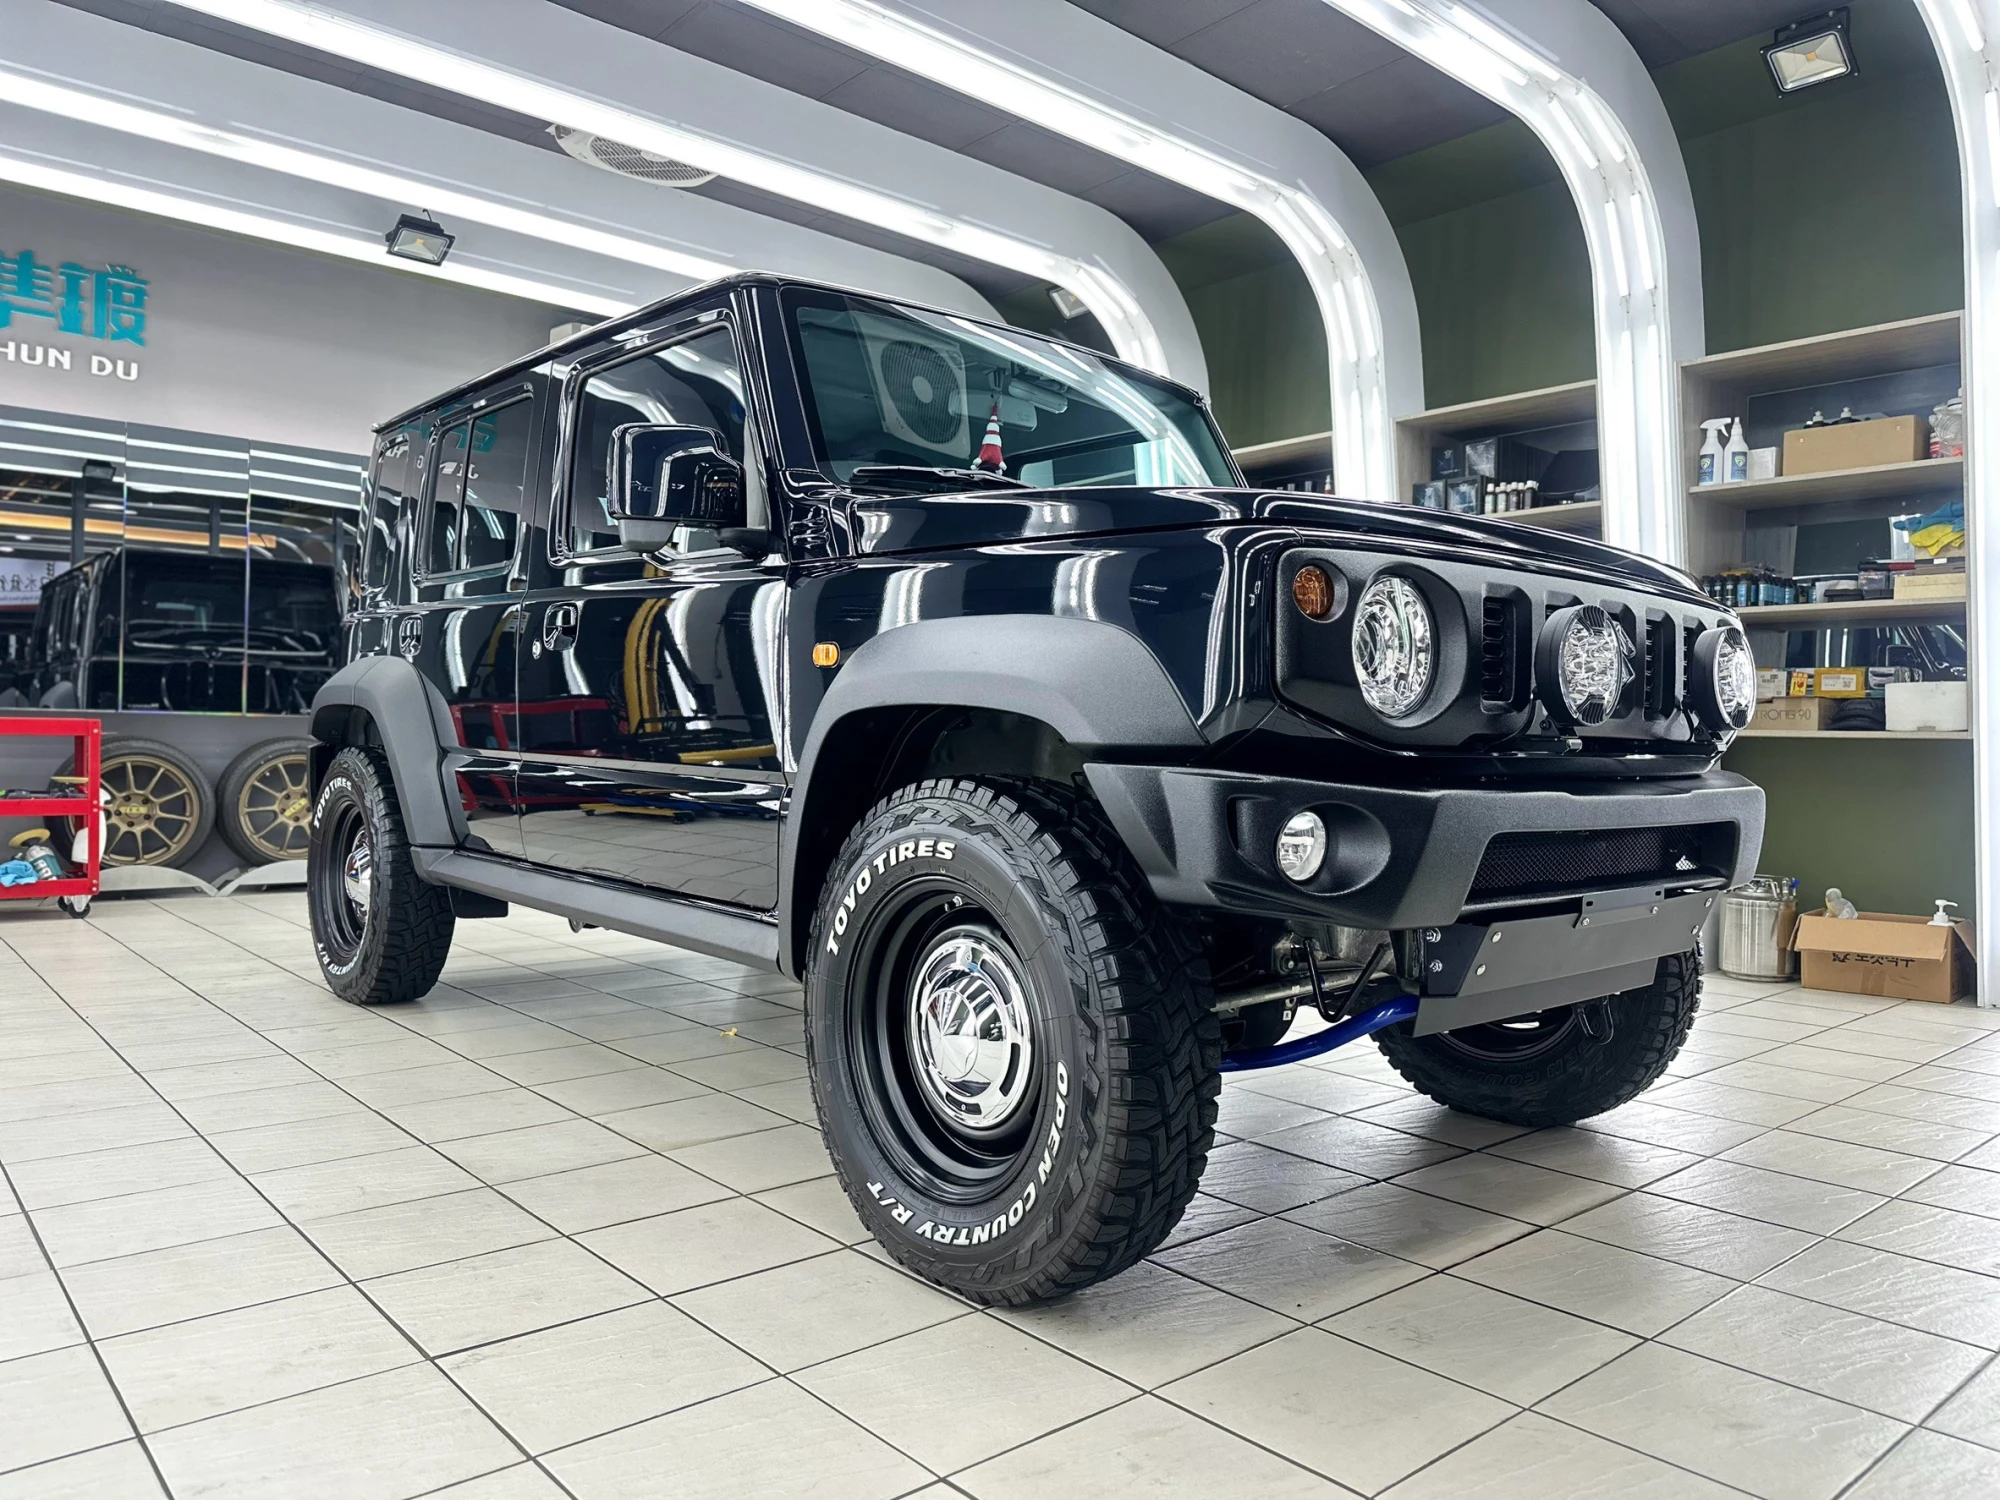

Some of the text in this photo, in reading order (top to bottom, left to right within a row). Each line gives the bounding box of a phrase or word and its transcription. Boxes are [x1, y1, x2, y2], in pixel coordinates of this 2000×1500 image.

[91, 355, 139, 382] DU
[1798, 708, 1812, 721] 90
[313, 776, 352, 829] TOYO TIRES
[827, 863, 888, 956] TOYO
[872, 838, 957, 877] TIRES
[316, 942, 331, 965] R/T
[1036, 1061, 1069, 1187] OPEN
[865, 1180, 915, 1227] R/T
[914, 1180, 1038, 1247] COUNTRY
